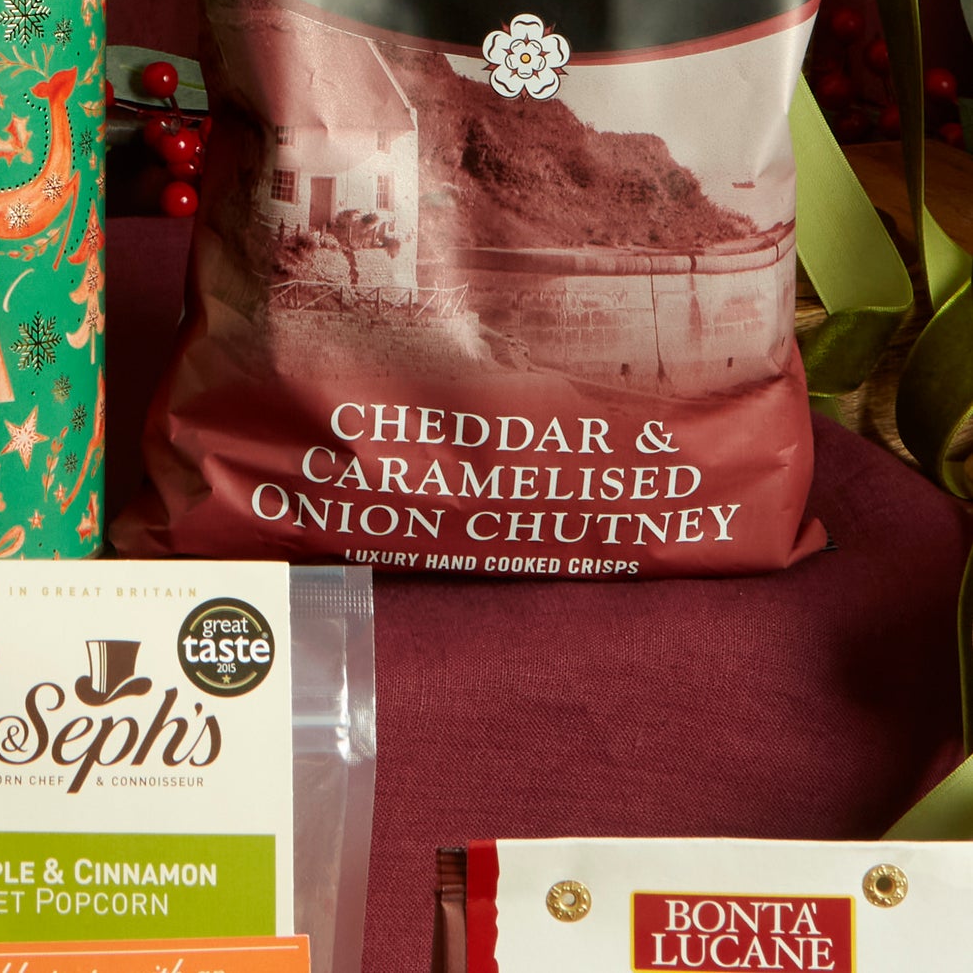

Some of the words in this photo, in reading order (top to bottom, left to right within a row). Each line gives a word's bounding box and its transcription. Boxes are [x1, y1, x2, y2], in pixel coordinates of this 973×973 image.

[330, 402, 614, 455] CHEDDAR
[635, 420, 680, 454] &
[301, 445, 702, 501] CARAMELISED
[251, 483, 443, 538] ONION
[466, 503, 741, 545] CHUTNEY
[345, 549, 419, 567] LUXURY
[426, 554, 477, 571] HAND
[484, 555, 561, 574] COOKED
[567, 557, 640, 575] CRISPS
[9, 586, 27, 596] IN
[42, 586, 102, 597] GREAT
[116, 587, 197, 598] BRITAIN
[202, 617, 250, 638] great
[182, 635, 271, 664] taste
[216, 662, 237, 674] 2015
[29, 775, 65, 786] CHEF
[96, 776, 105, 787] &
[112, 776, 205, 788] CONNOISSEUR
[43, 858, 65, 885] &
[74, 859, 217, 887] CINNAMON
[35, 887, 169, 916] POPCORN
[651, 933, 836, 971] LUCANE
